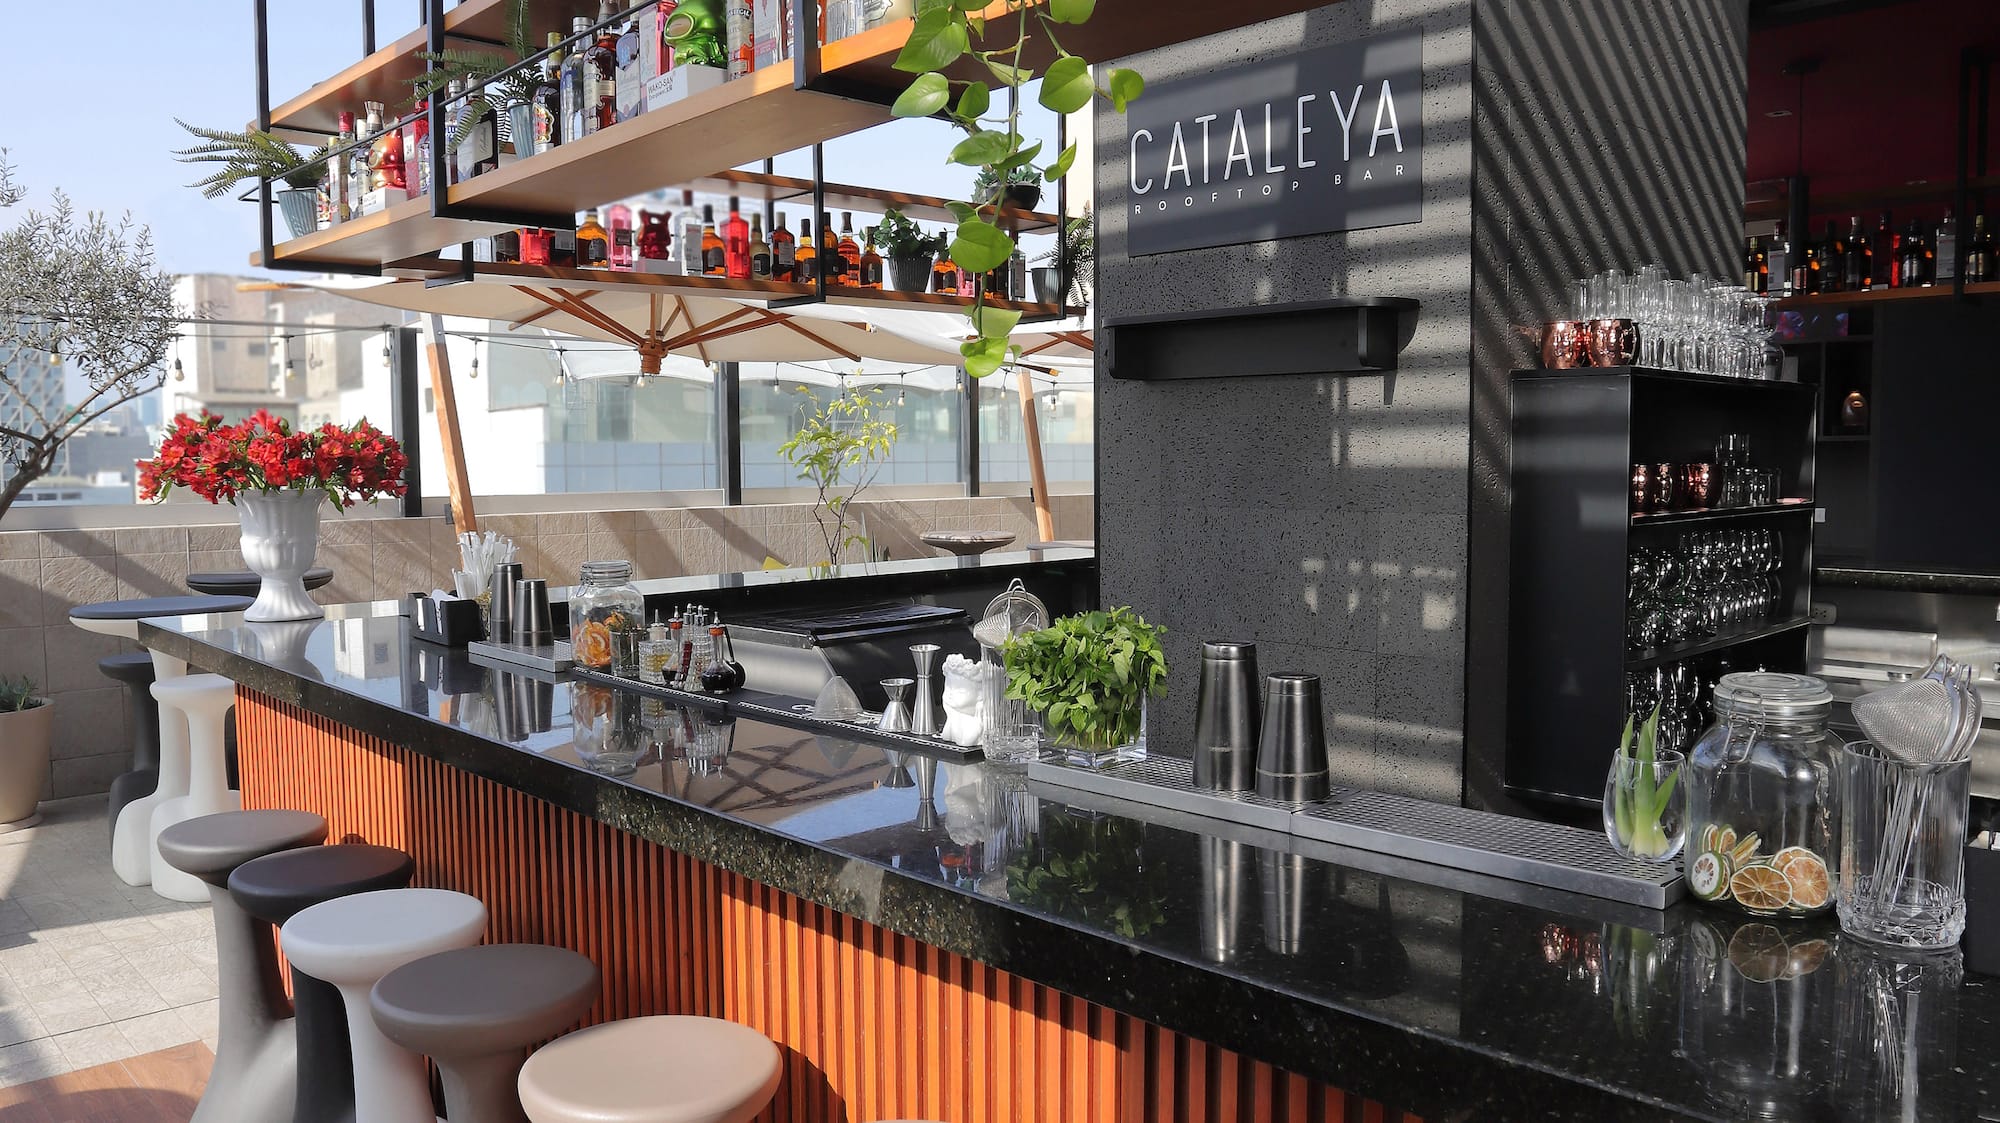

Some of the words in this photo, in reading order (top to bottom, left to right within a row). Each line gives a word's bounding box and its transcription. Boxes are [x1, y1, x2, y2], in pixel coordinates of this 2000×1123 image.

[1130, 79, 1403, 195] CATALEYA
[1134, 180, 1299, 215] ROOFTOP
[1334, 164, 1404, 185] BAR
